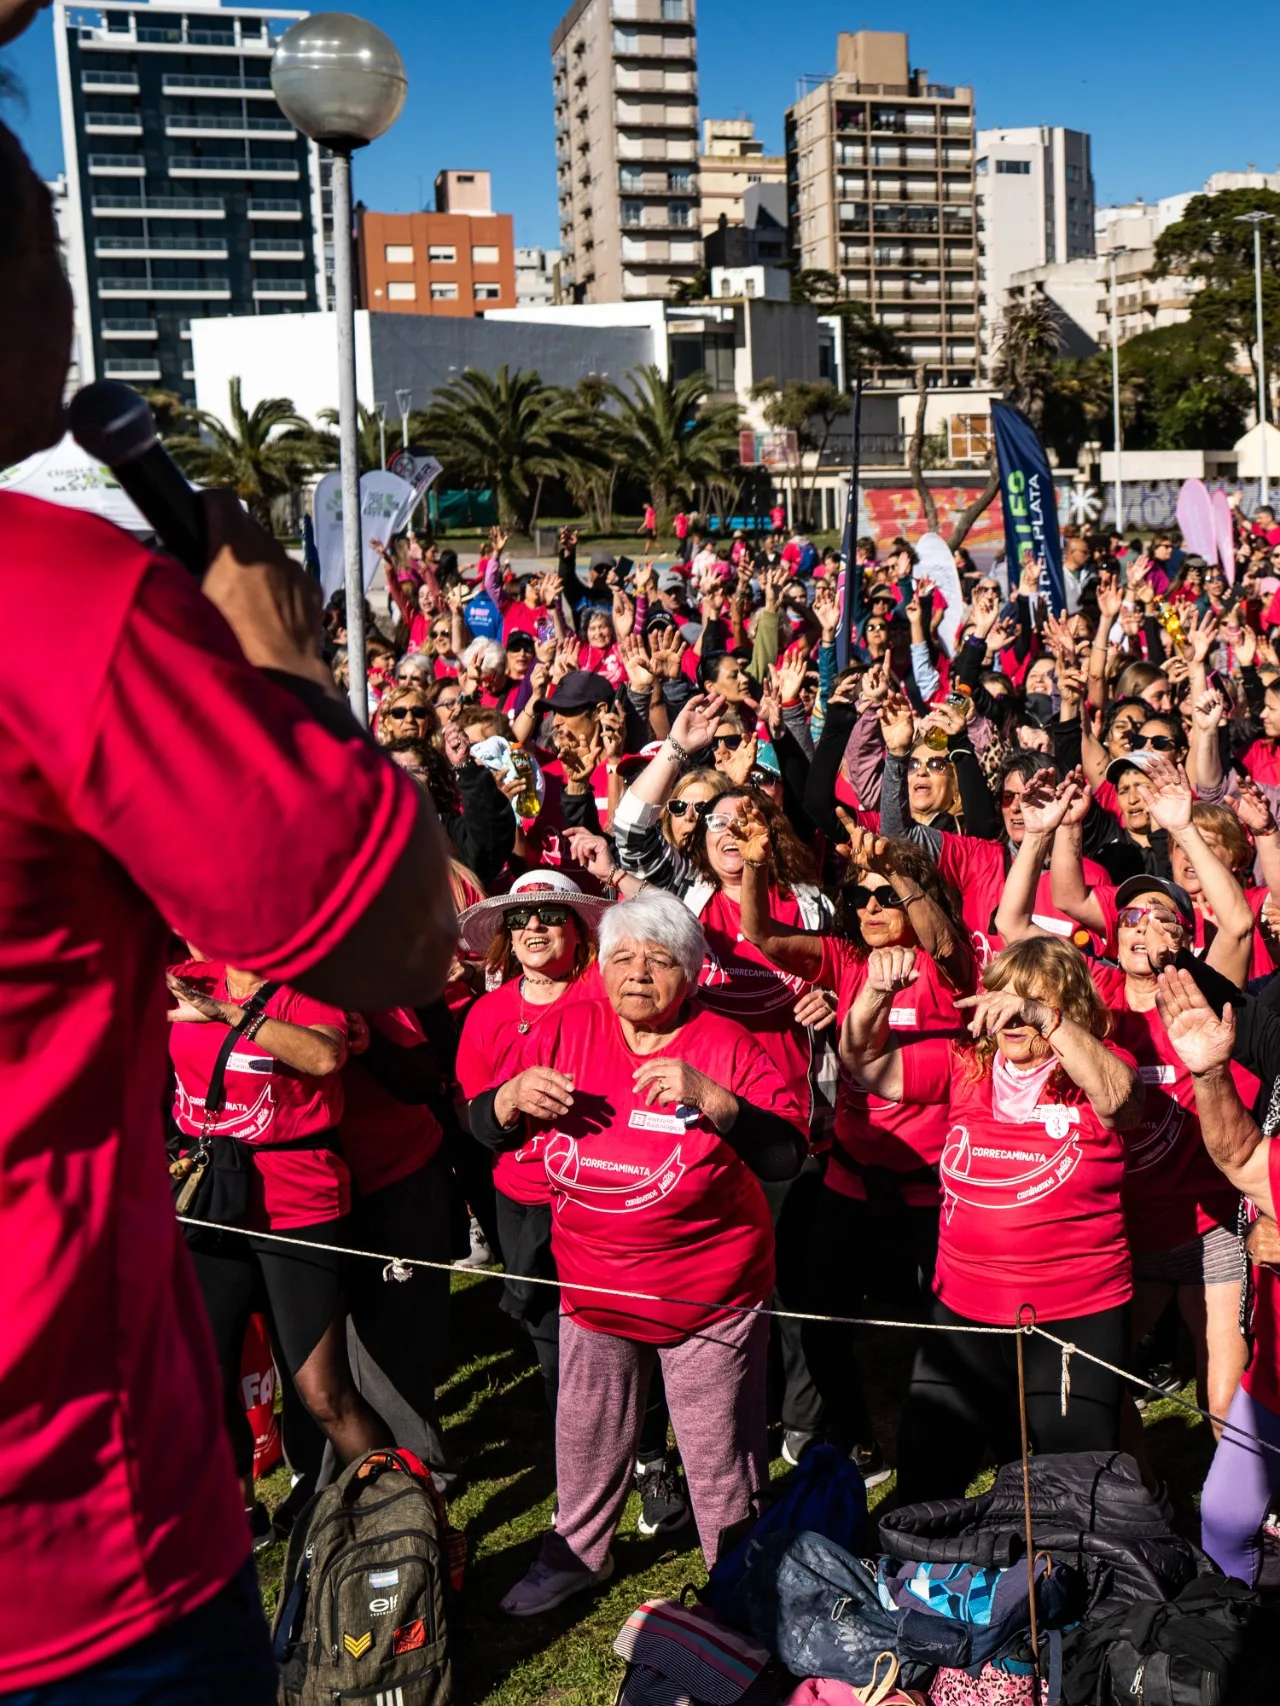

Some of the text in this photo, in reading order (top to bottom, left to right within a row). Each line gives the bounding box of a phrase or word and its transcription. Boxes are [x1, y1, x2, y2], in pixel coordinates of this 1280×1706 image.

[1029, 473, 1045, 540] PLATA
[725, 967, 786, 982] CORRECAMINATA
[972, 1147, 1047, 1163] CORRECAMINATA
[580, 1157, 651, 1176] CORRECAMINATA
[1016, 1176, 1055, 1201] caminemos
[625, 1189, 658, 1207] caminemos
[369, 1594, 399, 1612] elf
